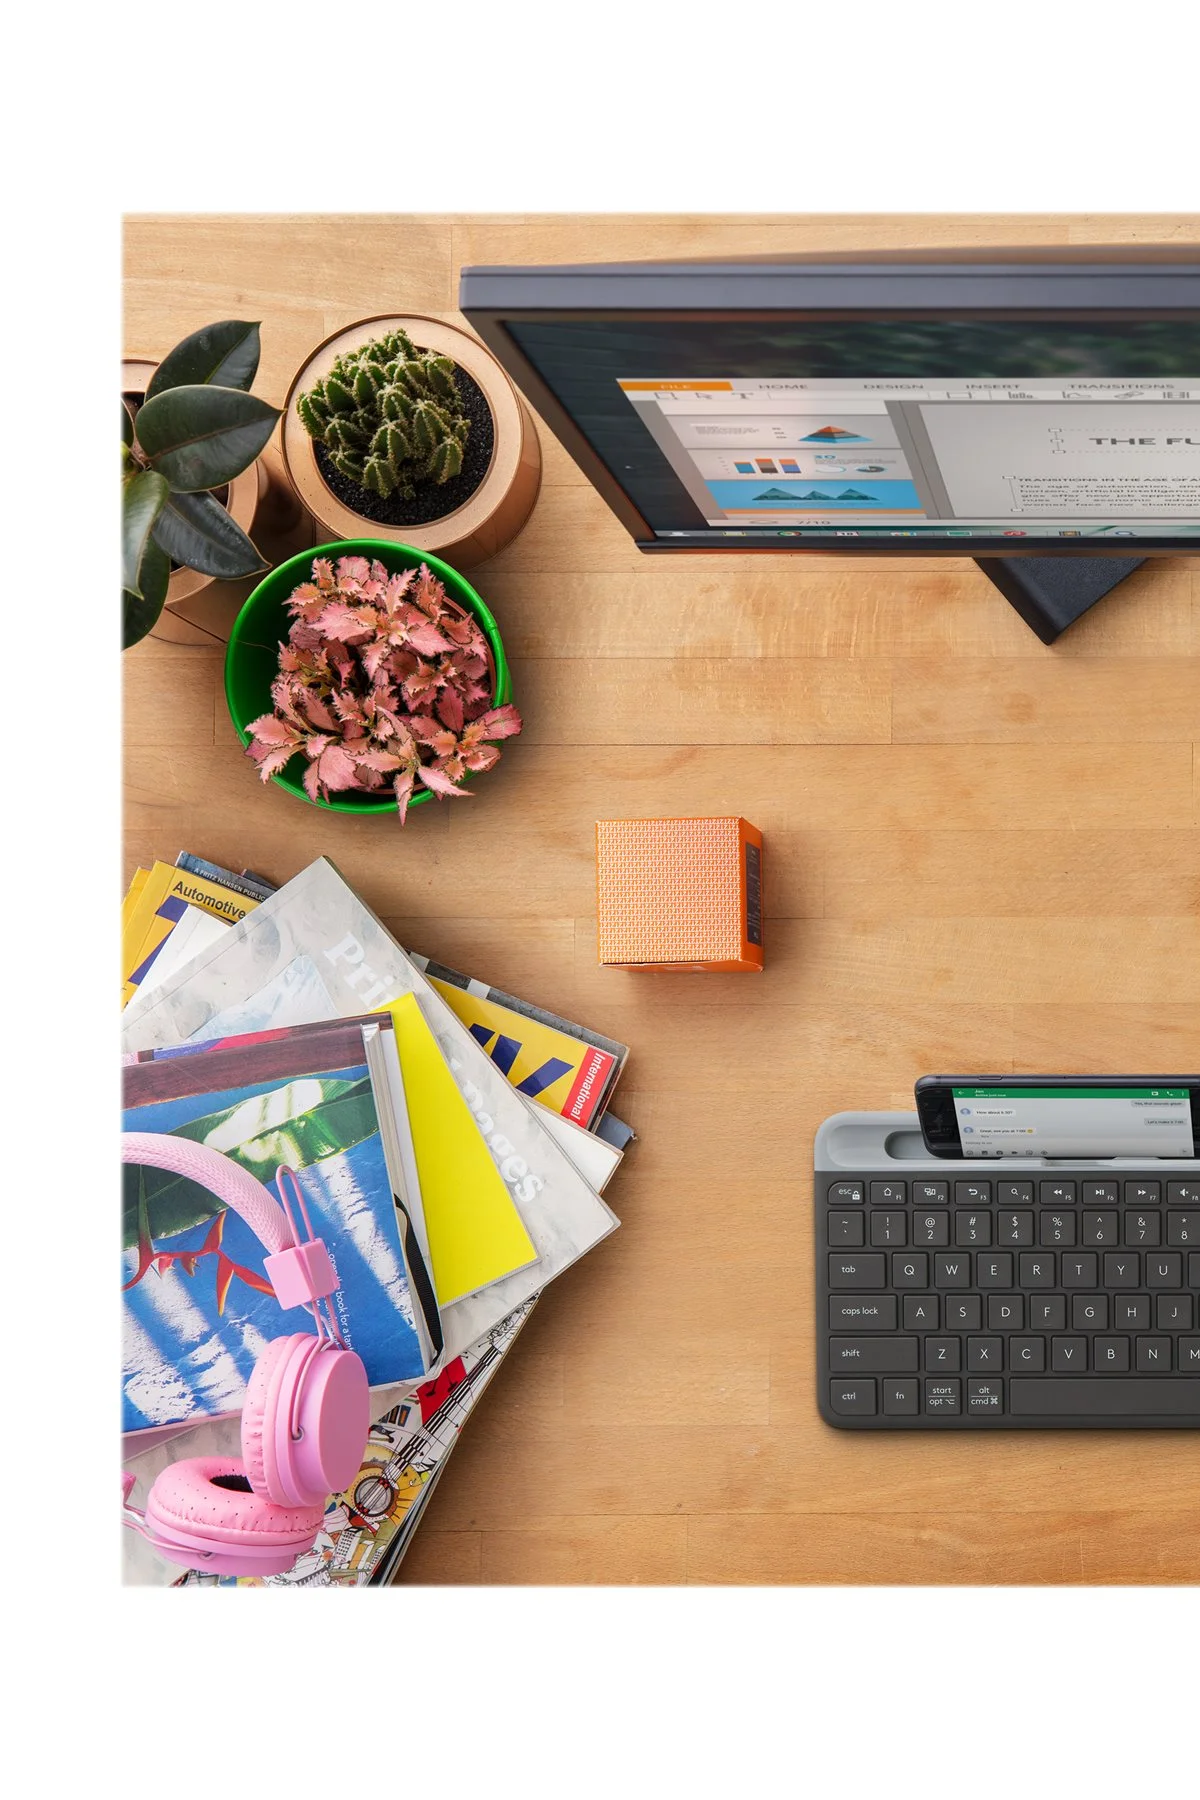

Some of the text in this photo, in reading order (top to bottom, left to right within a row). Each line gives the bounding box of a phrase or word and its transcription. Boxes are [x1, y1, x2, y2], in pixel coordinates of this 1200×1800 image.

[1089, 437, 1156, 445] THE
[199, 870, 217, 881] FRITZ
[217, 877, 244, 892] HANSEN
[173, 881, 247, 920] Automotive
[569, 1052, 605, 1121] International
[927, 1230, 934, 1239] 2
[969, 1230, 977, 1239] 3
[1011, 1231, 1019, 1239] 4
[1054, 1230, 1061, 1239] 5
[1096, 1231, 1104, 1239] 6
[1139, 1231, 1146, 1239] 7
[1181, 1231, 1188, 1239] 8
[903, 1265, 915, 1275] Q
[945, 1265, 959, 1274] W
[990, 1265, 998, 1275] E
[1032, 1265, 1041, 1274] R
[1075, 1265, 1083, 1275] T
[1117, 1266, 1125, 1274] Y
[1158, 1266, 1168, 1275] U
[335, 1290, 348, 1313] book
[915, 1308, 926, 1316] A
[959, 1307, 967, 1317] S
[1001, 1307, 1011, 1317] D
[1044, 1307, 1051, 1317] F
[1084, 1307, 1095, 1317] G
[1127, 1308, 1137, 1317] H
[1171, 1308, 1178, 1317] J
[340, 1313, 350, 1327] for
[938, 1349, 946, 1359] Z
[980, 1349, 989, 1358] X
[1021, 1349, 1031, 1359] C
[1064, 1349, 1073, 1358] V
[1107, 1349, 1116, 1359] B
[1148, 1350, 1158, 1358] N
[1190, 1350, 1200, 1359] M
[929, 1398, 943, 1406] opt
[971, 1397, 989, 1405] cmd
